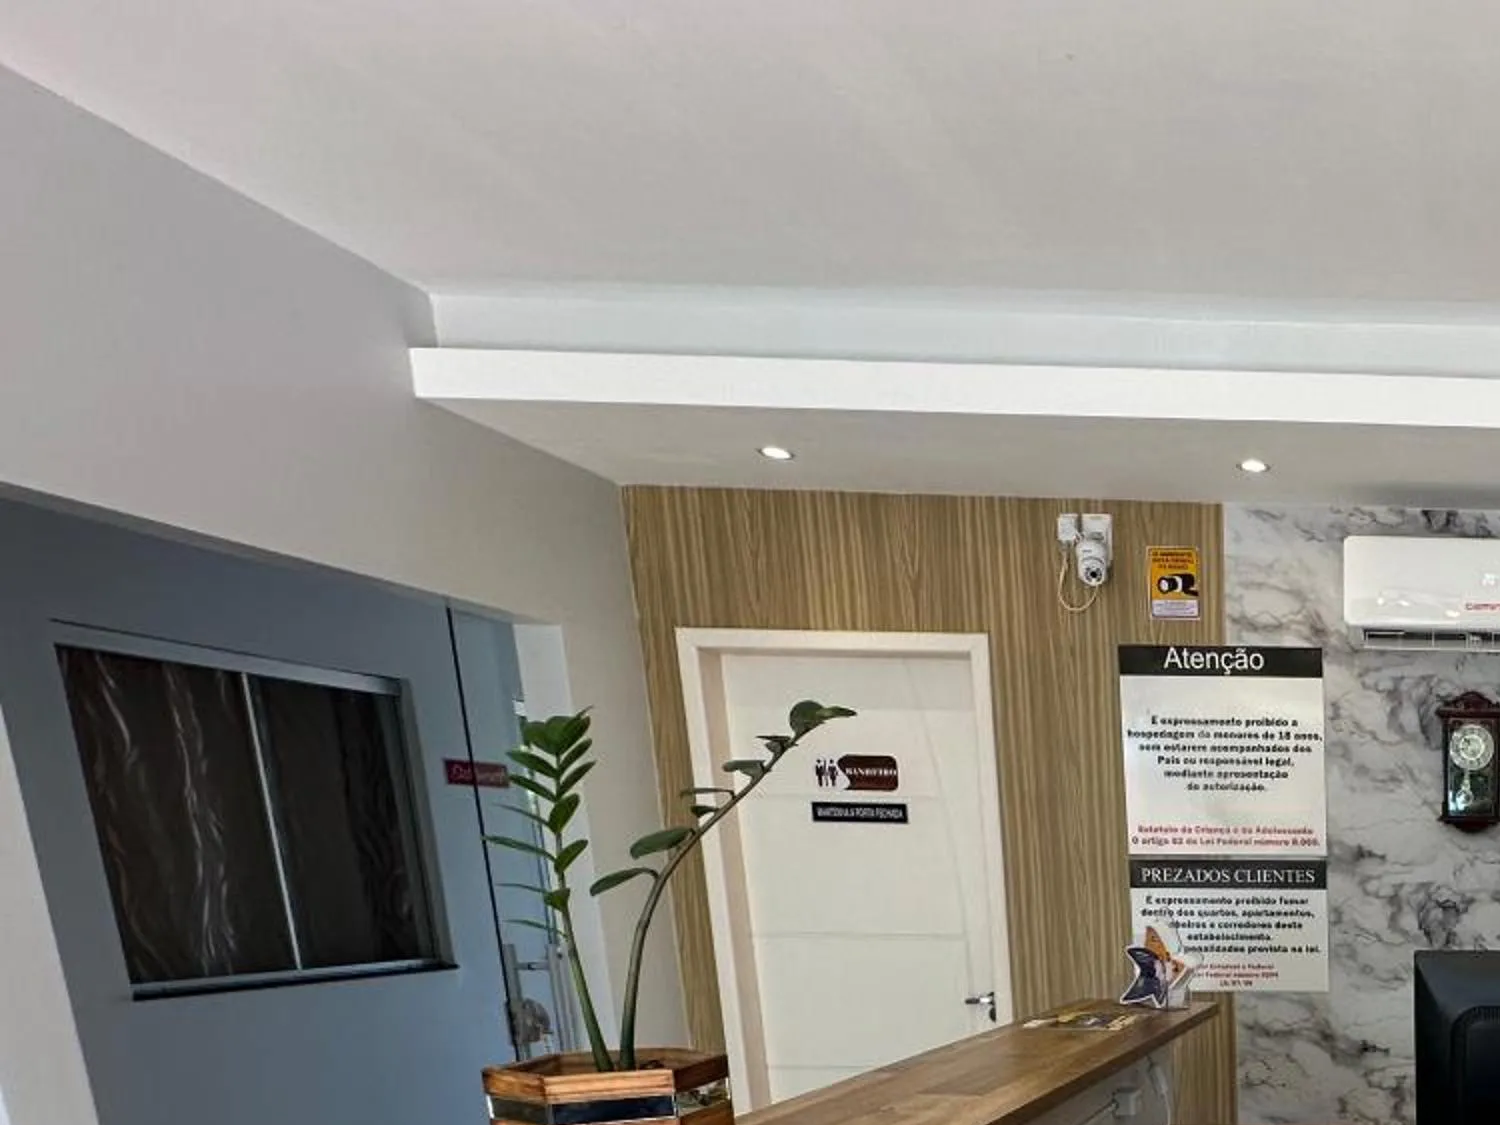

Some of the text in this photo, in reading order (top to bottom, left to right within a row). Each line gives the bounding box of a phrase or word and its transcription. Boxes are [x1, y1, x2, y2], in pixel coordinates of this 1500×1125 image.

[1164, 646, 1264, 674] Atenção
[1245, 717, 1288, 727] proibido
[1127, 730, 1194, 740] hospedagem
[1214, 731, 1259, 740] menores
[1262, 732, 1275, 740] de
[1278, 732, 1291, 740] 18
[1210, 745, 1290, 754] acompanhados
[1157, 756, 1180, 764] Pais
[1200, 836, 1214, 845] Lei
[1140, 867, 1316, 883] PREZADOS CLIENTES
[1235, 897, 1276, 906] proibido
